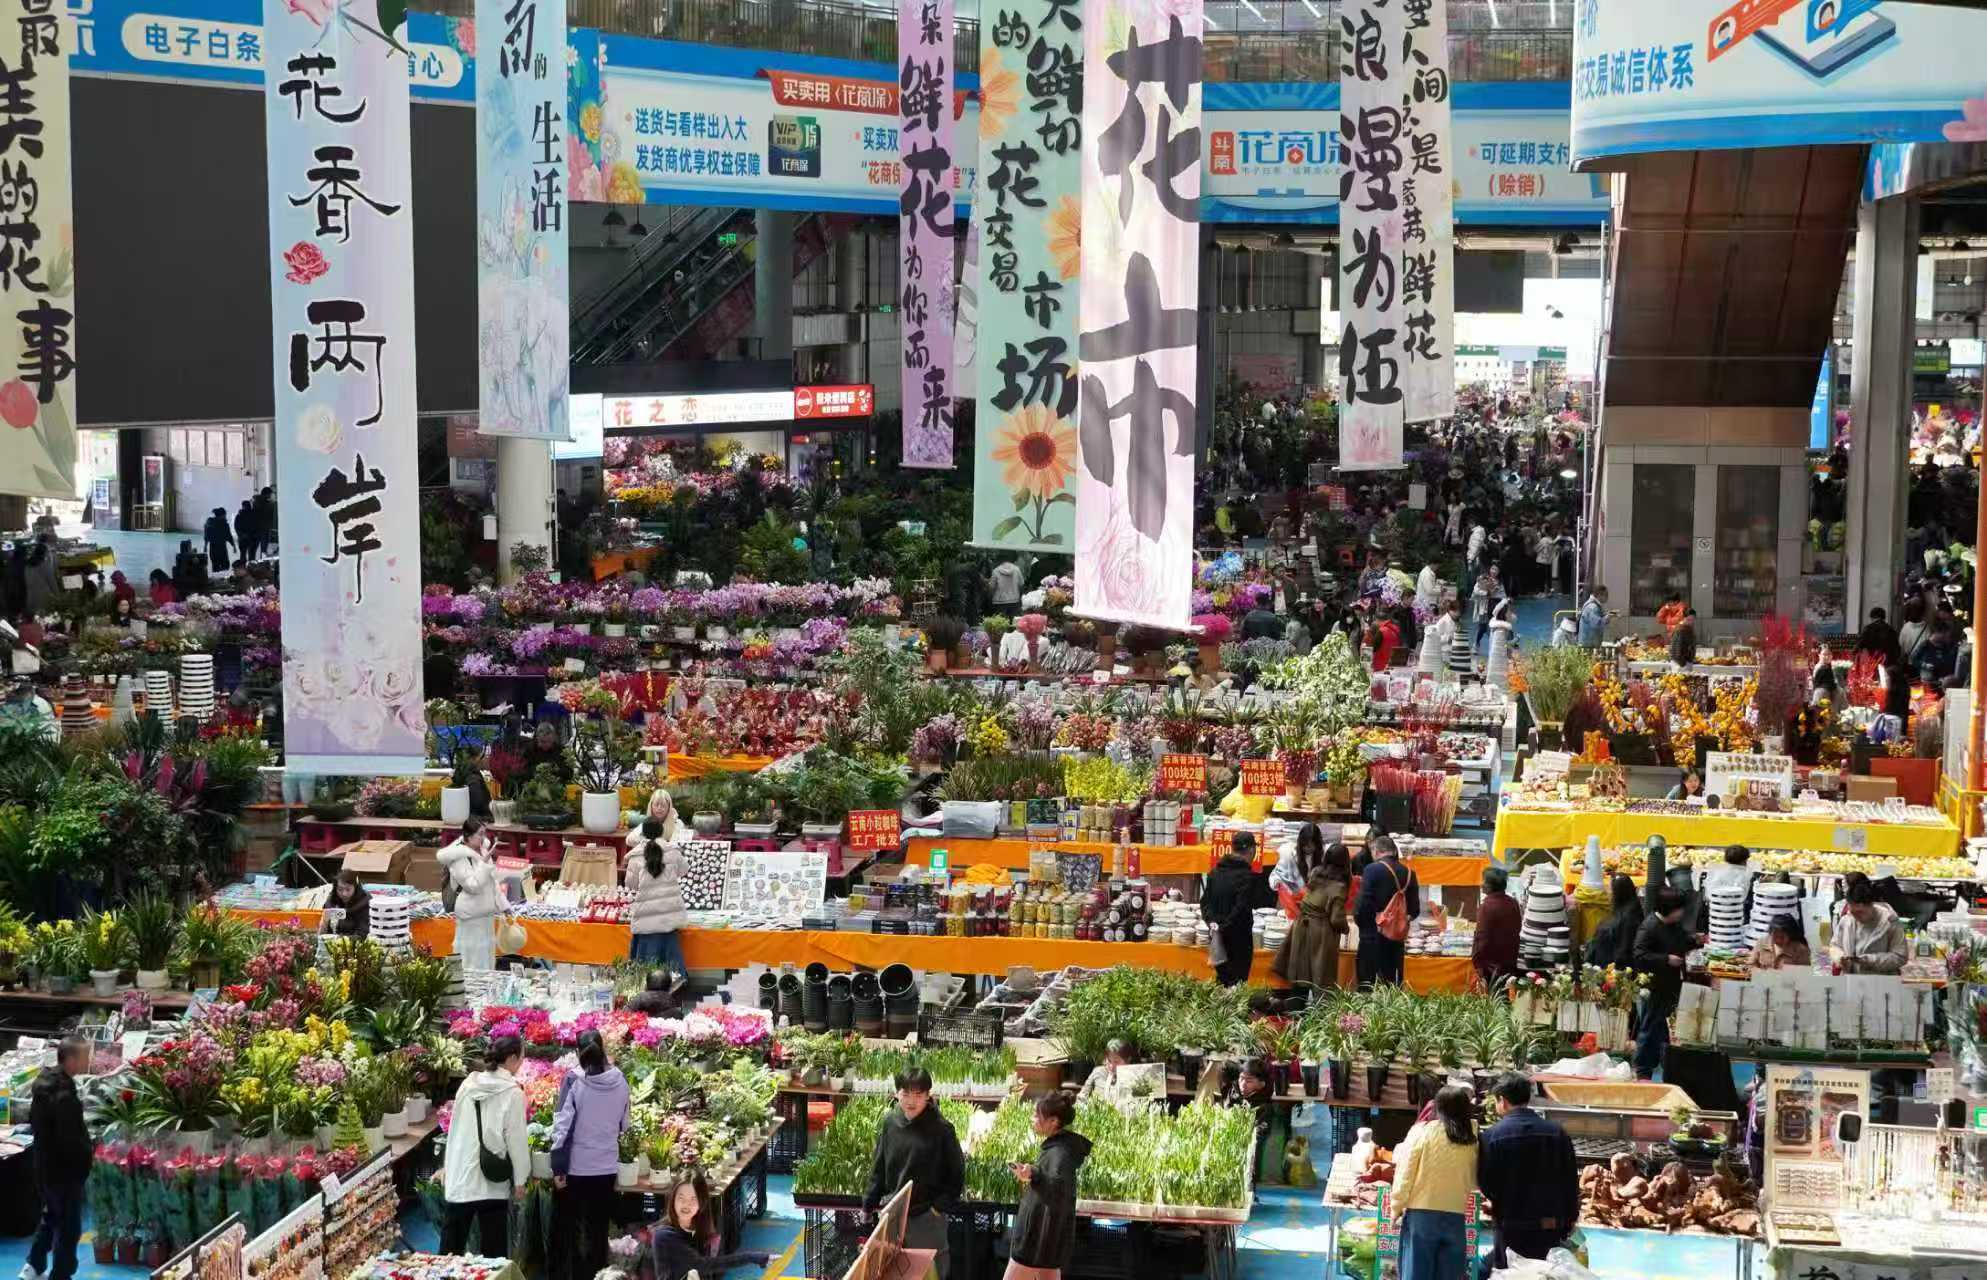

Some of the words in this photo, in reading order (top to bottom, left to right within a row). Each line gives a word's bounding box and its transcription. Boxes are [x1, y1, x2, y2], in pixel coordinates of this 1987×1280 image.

[145, 22, 262, 62] 电子白条
[635, 107, 748, 142] 送货与看样出入大
[635, 144, 762, 177] 发货商优享权益保障
[1480, 142, 1571, 165] 可延期支付
[1079, 14, 1201, 544] 花市
